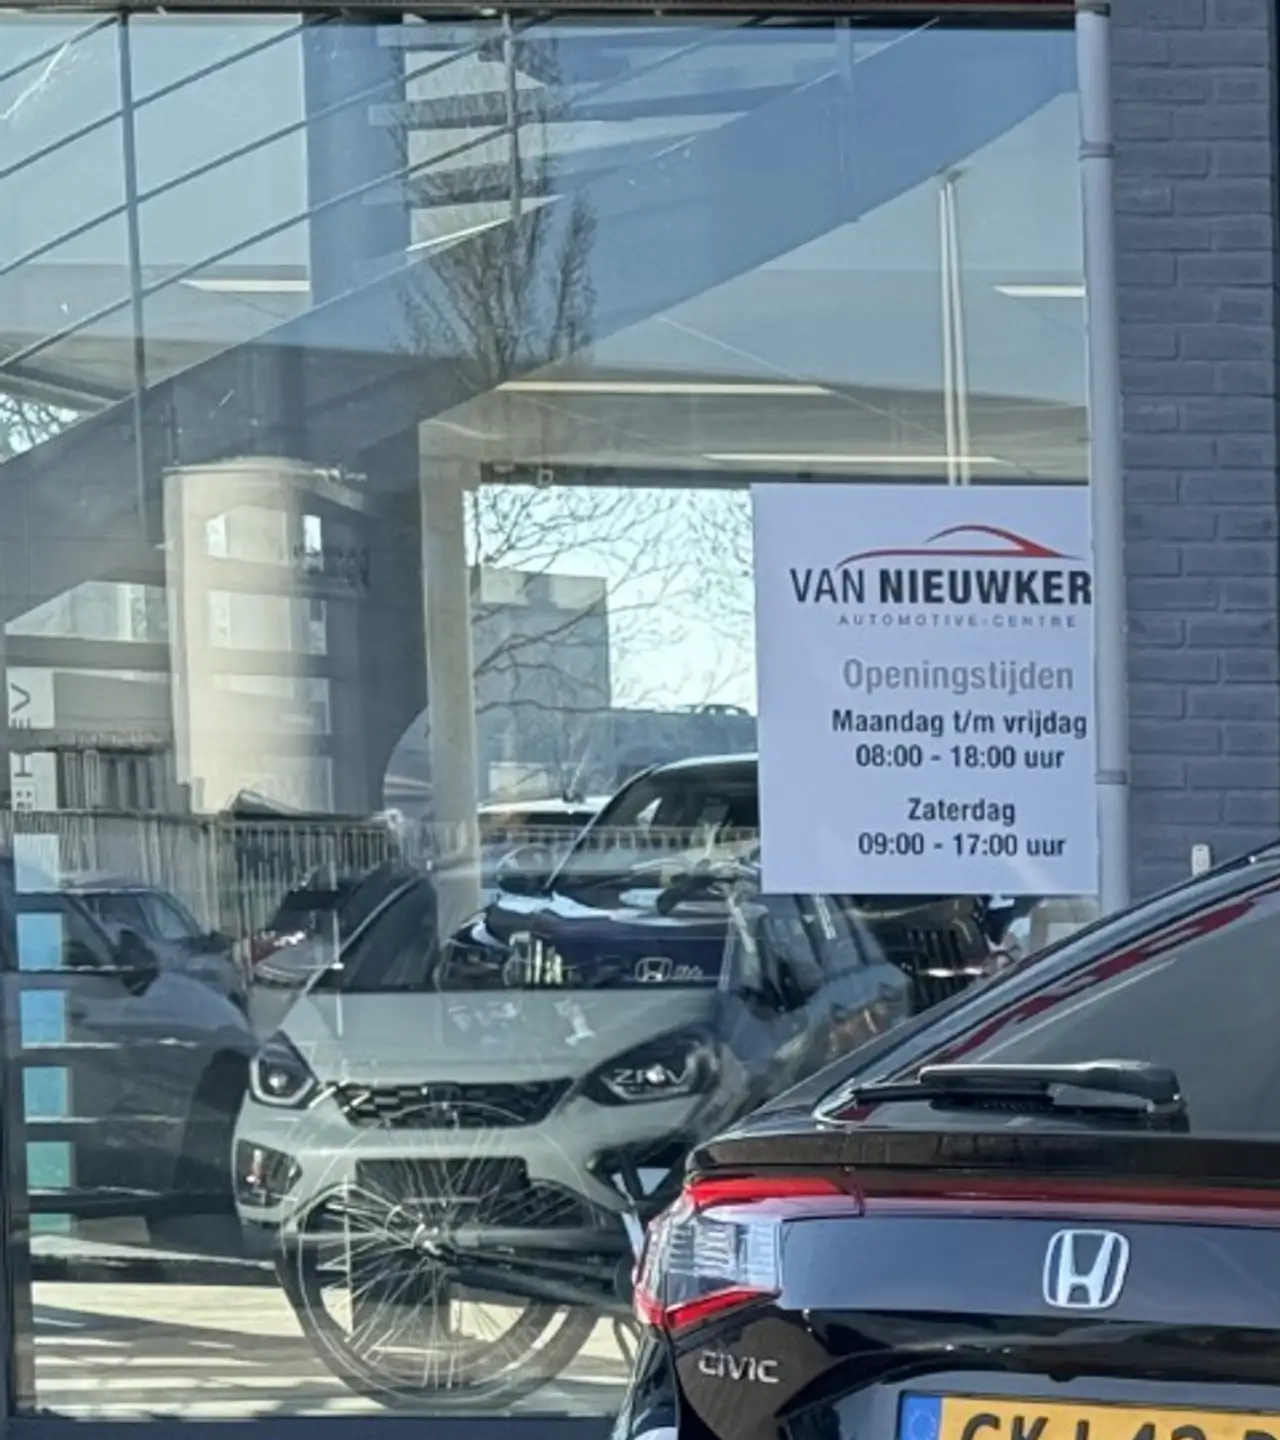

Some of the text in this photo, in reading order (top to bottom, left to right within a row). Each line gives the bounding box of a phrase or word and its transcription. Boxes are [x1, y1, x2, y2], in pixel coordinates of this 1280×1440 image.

[789, 567, 1093, 606] VAN NIEUWKER
[843, 658, 1074, 695] Openingstijden
[832, 708, 1088, 739] Maandag t/m vrijdag
[856, 744, 923, 768] 08:00
[950, 745, 1017, 769] 18:00
[1024, 749, 1066, 769] uur
[907, 797, 1016, 827] Zaterdag
[858, 832, 925, 856] 09:00
[953, 833, 1018, 857] 17:00
[1026, 837, 1067, 857] uur
[698, 1350, 779, 1383] CIVIC
